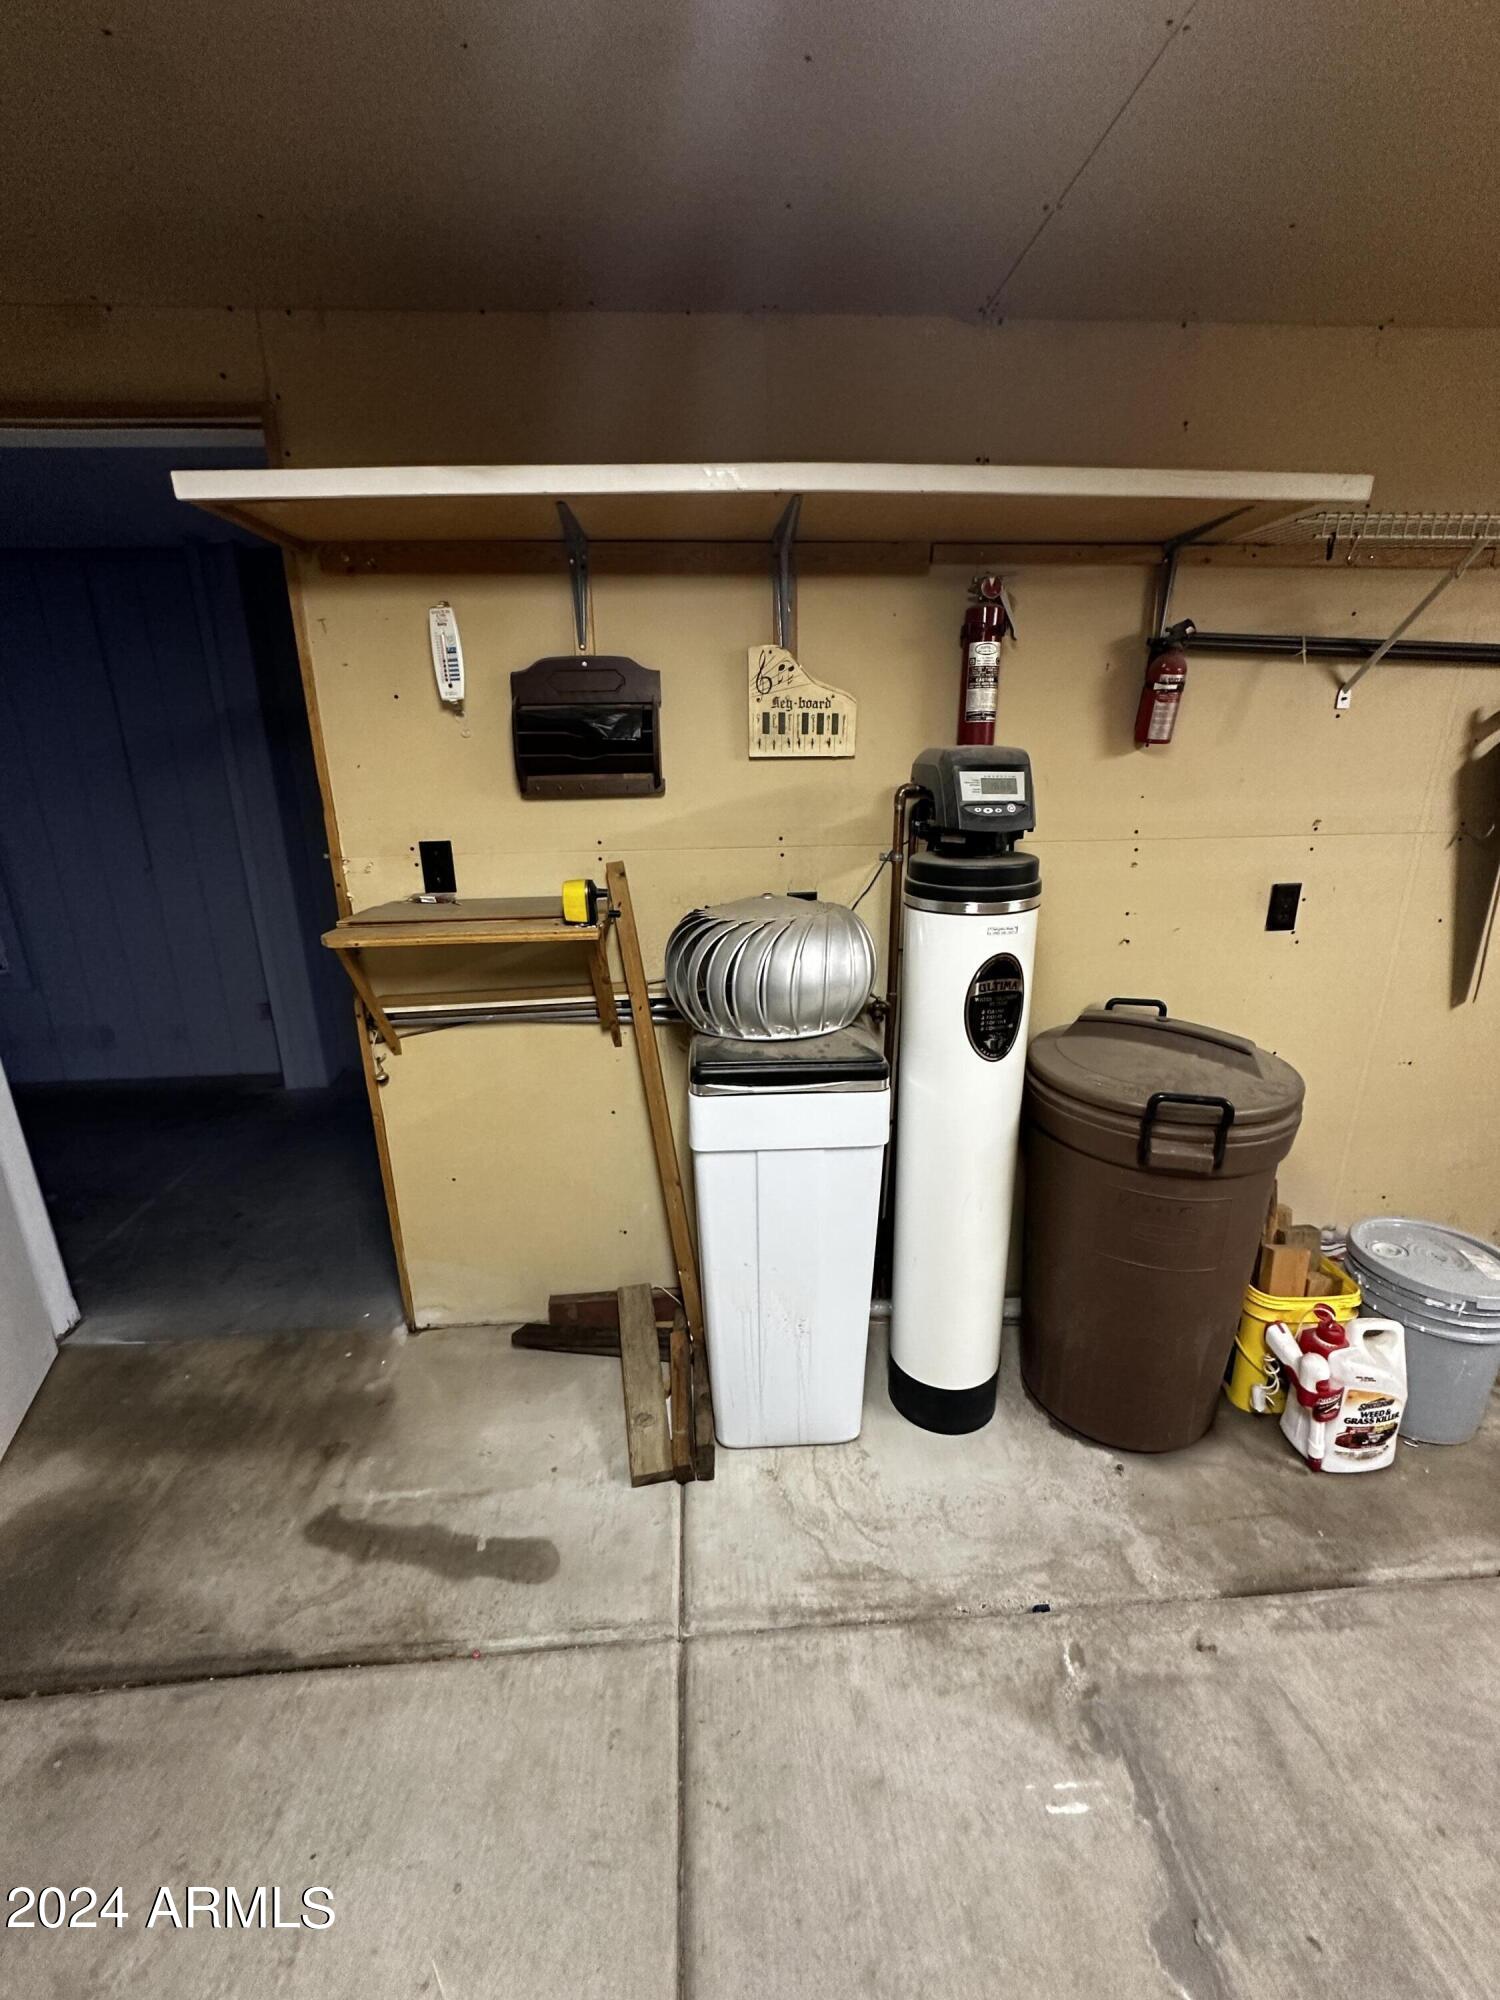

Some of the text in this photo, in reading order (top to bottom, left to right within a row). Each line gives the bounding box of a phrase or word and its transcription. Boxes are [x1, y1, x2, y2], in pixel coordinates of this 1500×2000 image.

[771, 696, 832, 711] Key-board
[979, 980, 1018, 993] ULTIMA
[1344, 1411, 1400, 1425] GRASS KILLER
[1360, 1409, 1384, 1418] WEED
